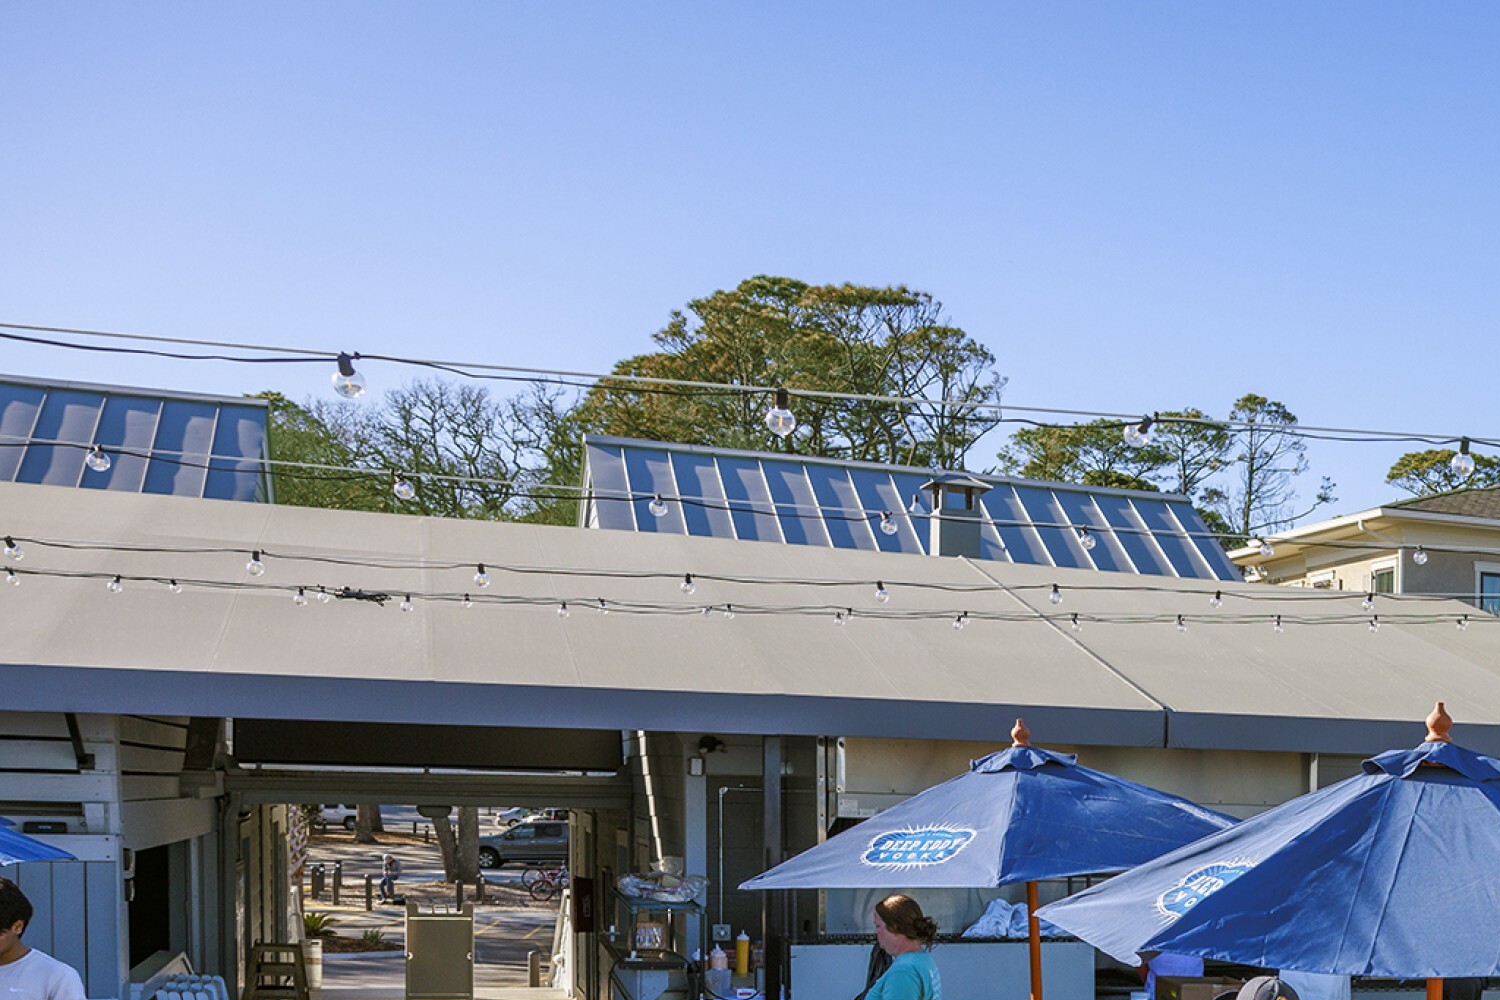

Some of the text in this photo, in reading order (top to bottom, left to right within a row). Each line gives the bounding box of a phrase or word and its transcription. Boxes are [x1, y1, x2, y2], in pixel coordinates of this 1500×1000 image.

[879, 838, 966, 851] DEEP EDDY
[880, 851, 945, 859] VODKA
